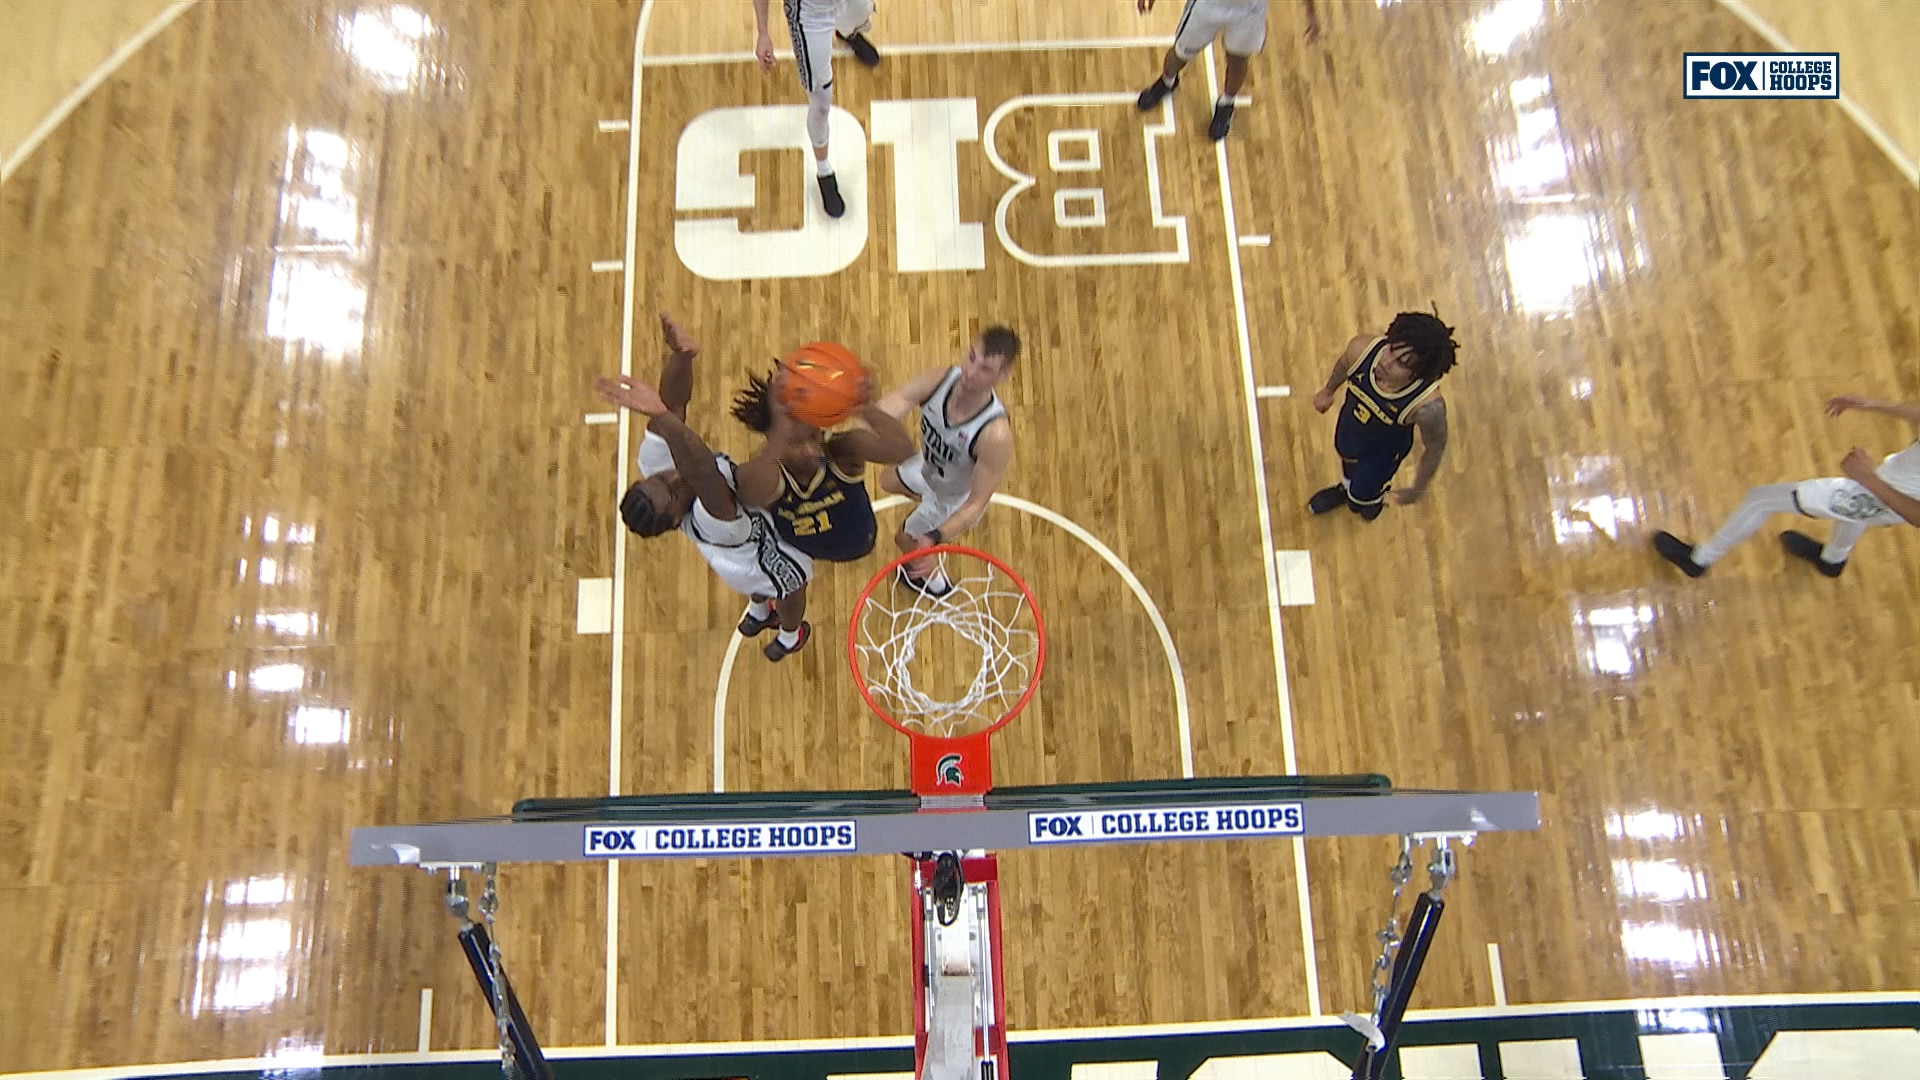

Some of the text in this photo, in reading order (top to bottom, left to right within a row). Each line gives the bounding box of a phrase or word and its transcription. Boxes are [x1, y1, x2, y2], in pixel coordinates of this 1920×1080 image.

[1353, 402, 1371, 425] 3
[792, 510, 832, 536] 21
[1035, 807, 1299, 838] FOX COLLEGE HOOPS
[590, 825, 852, 850] FOX COLLEGE HOOPS
